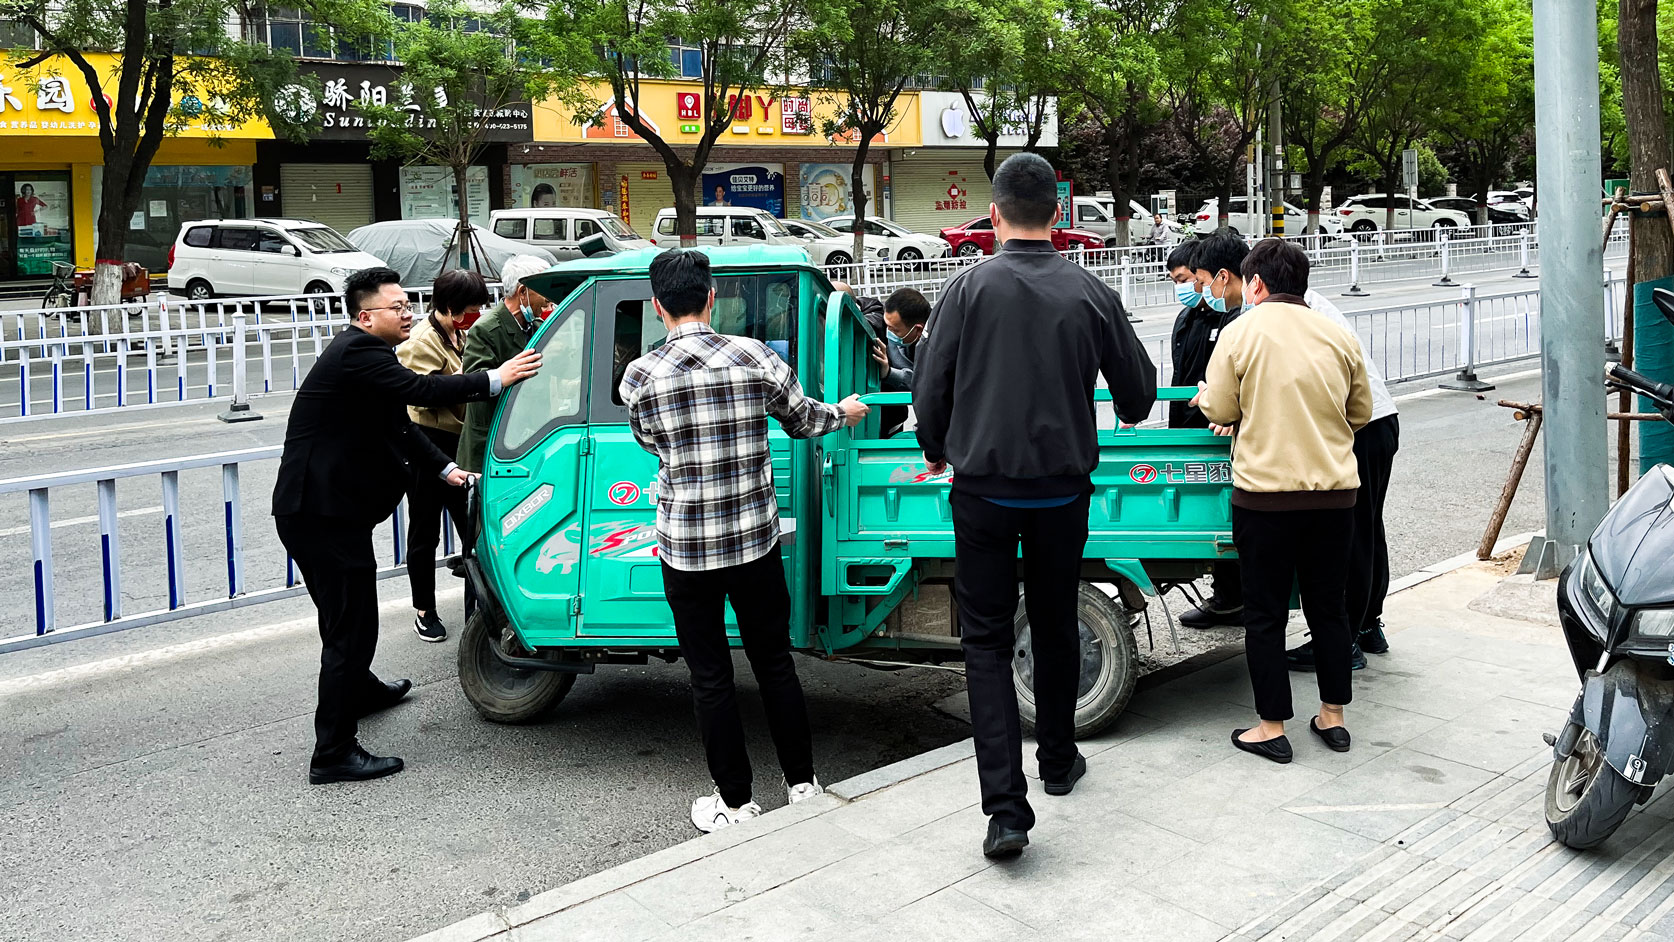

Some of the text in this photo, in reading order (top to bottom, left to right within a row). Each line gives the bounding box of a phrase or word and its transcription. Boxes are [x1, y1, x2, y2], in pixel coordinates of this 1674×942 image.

[783, 99, 808, 112] 时尚
[681, 109, 699, 117] HBL
[1160, 462, 1233, 483] 七星豹
